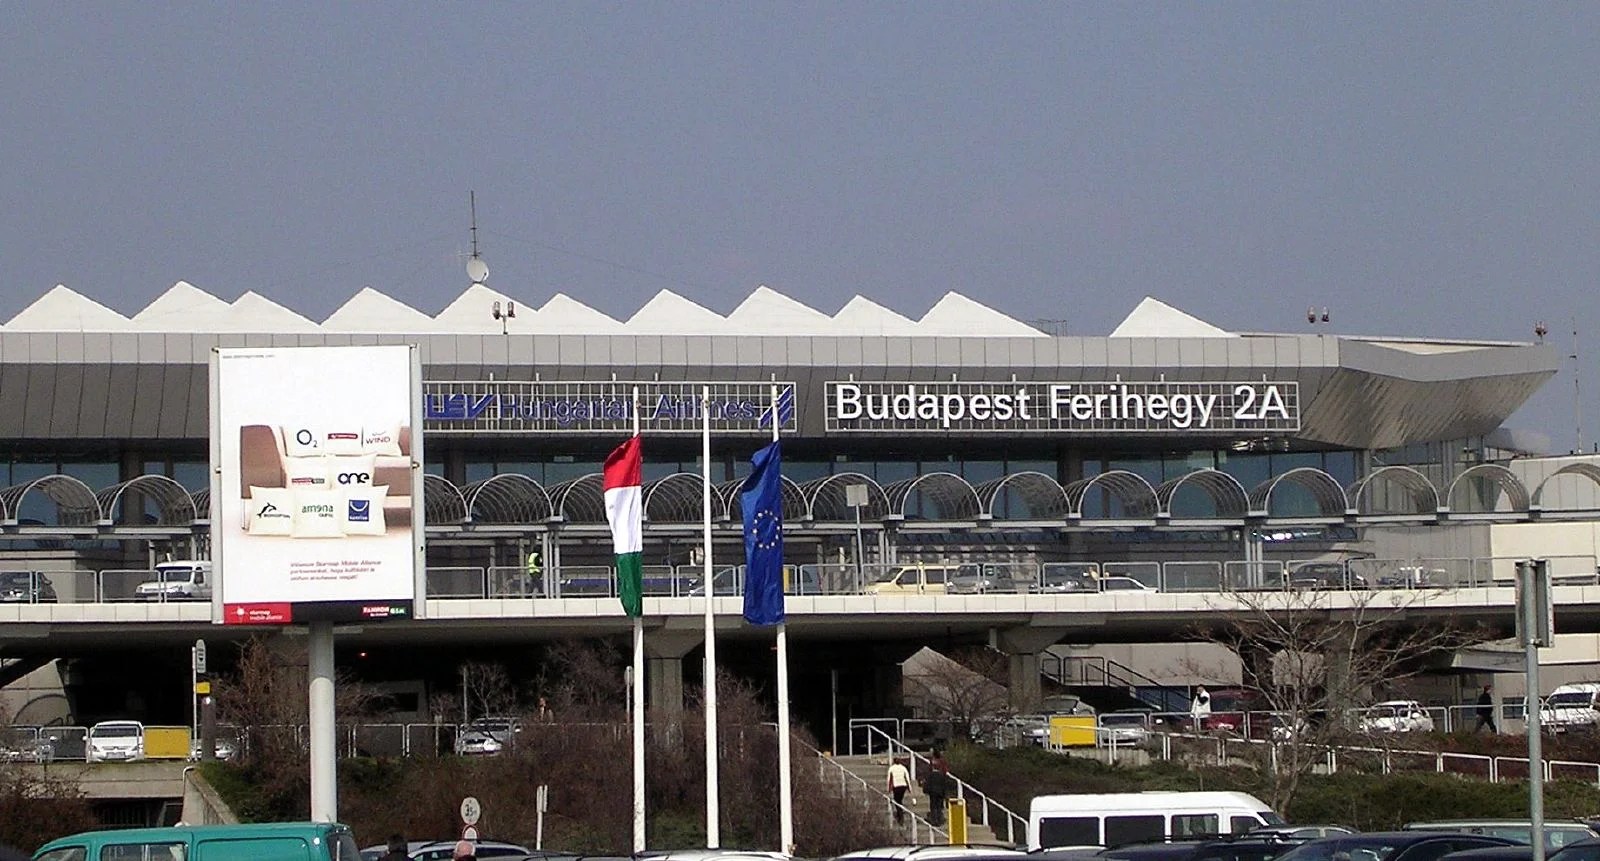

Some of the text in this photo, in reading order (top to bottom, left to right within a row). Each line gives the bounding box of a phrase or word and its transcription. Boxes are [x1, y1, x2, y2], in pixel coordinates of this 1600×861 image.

[836, 384, 1289, 428] Budapest Ferihegy 2A
